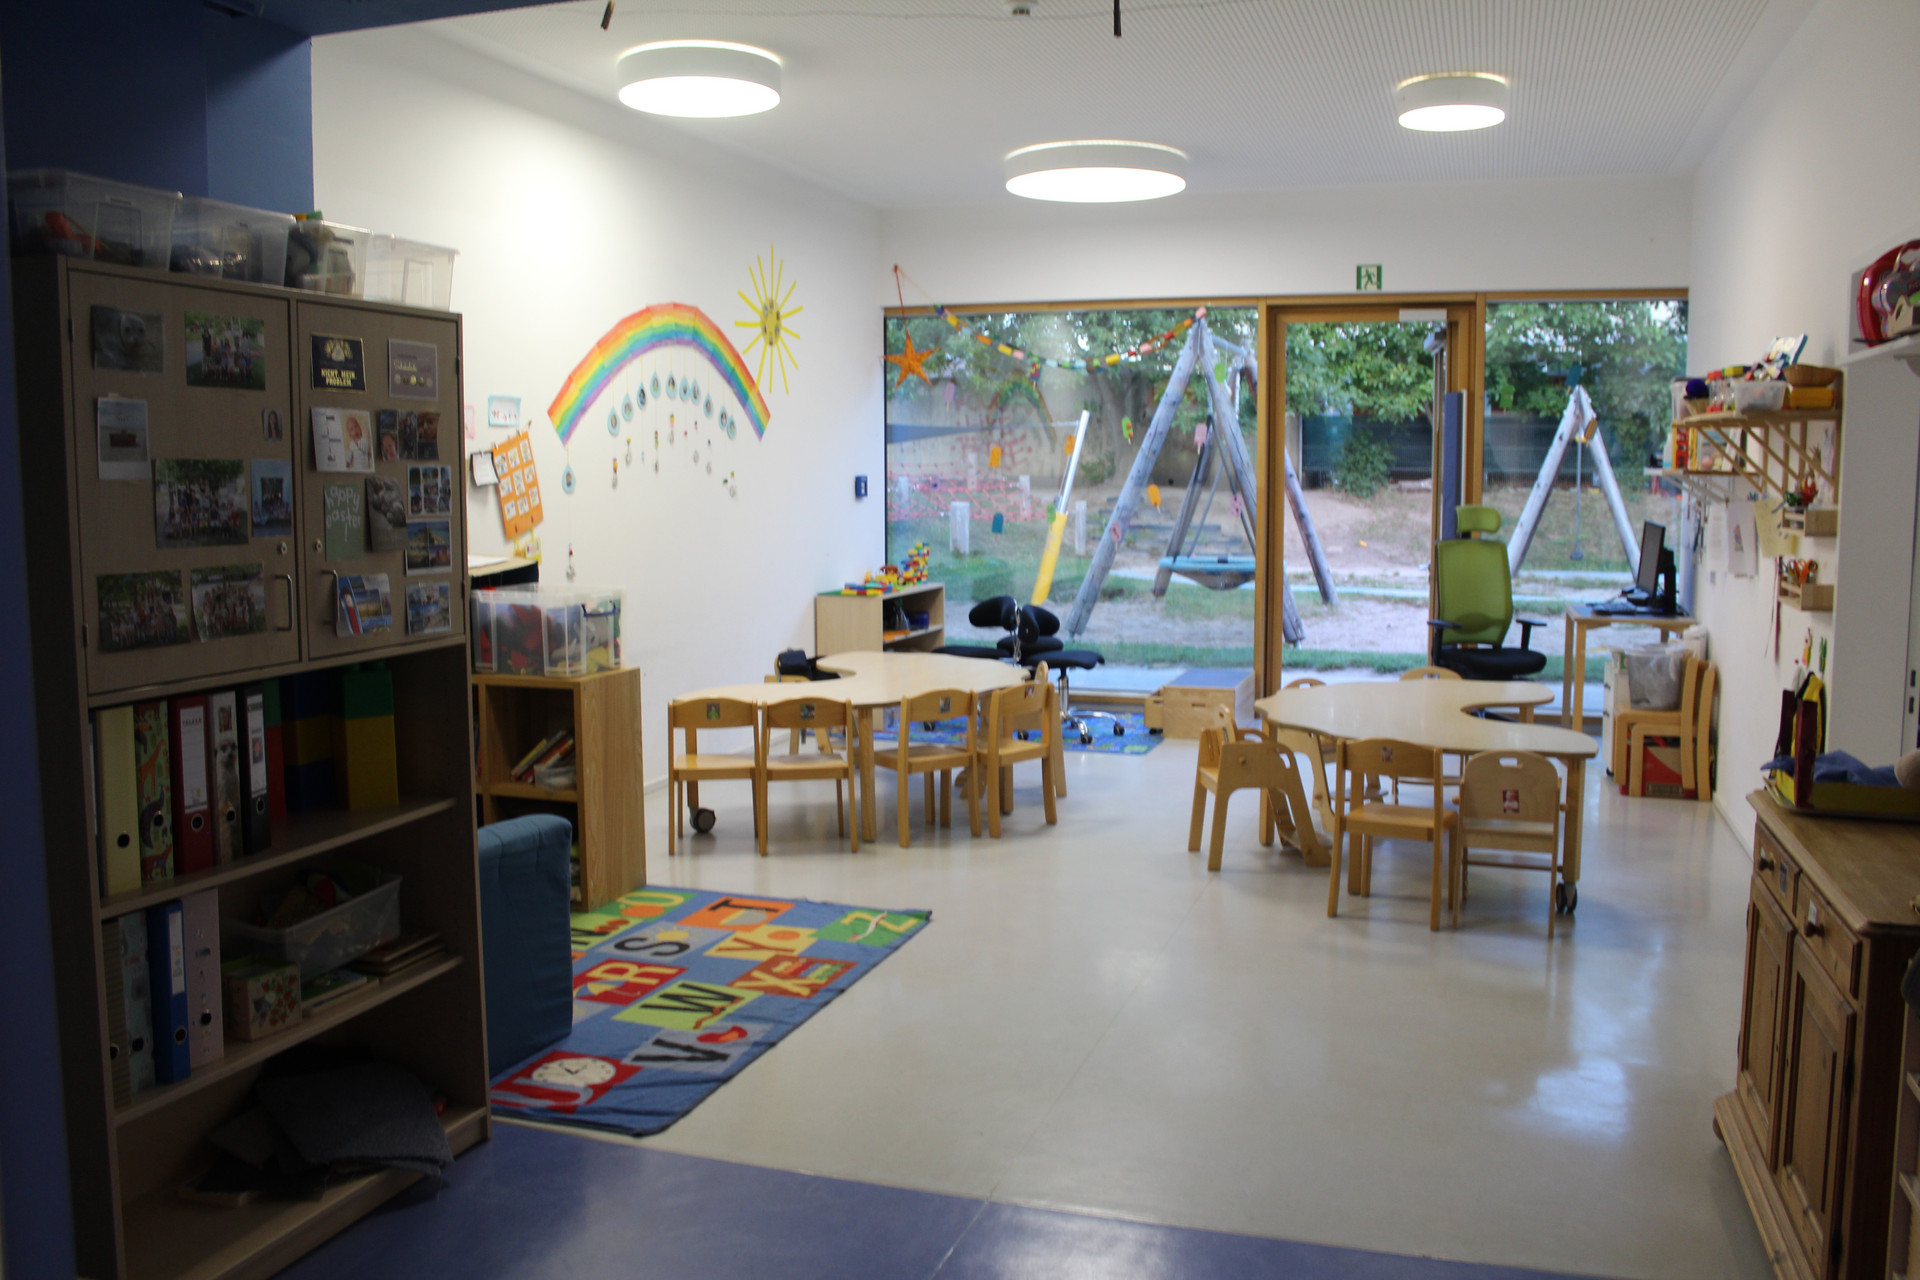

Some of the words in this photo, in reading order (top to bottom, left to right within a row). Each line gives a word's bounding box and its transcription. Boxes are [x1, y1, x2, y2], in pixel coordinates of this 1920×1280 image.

[324, 486, 361, 513] happy
[614, 937, 690, 957] S
[715, 936, 796, 953] Y
[585, 962, 680, 986] R
[733, 969, 828, 997] X
[639, 983, 746, 1013] W
[631, 1037, 731, 1062] V
